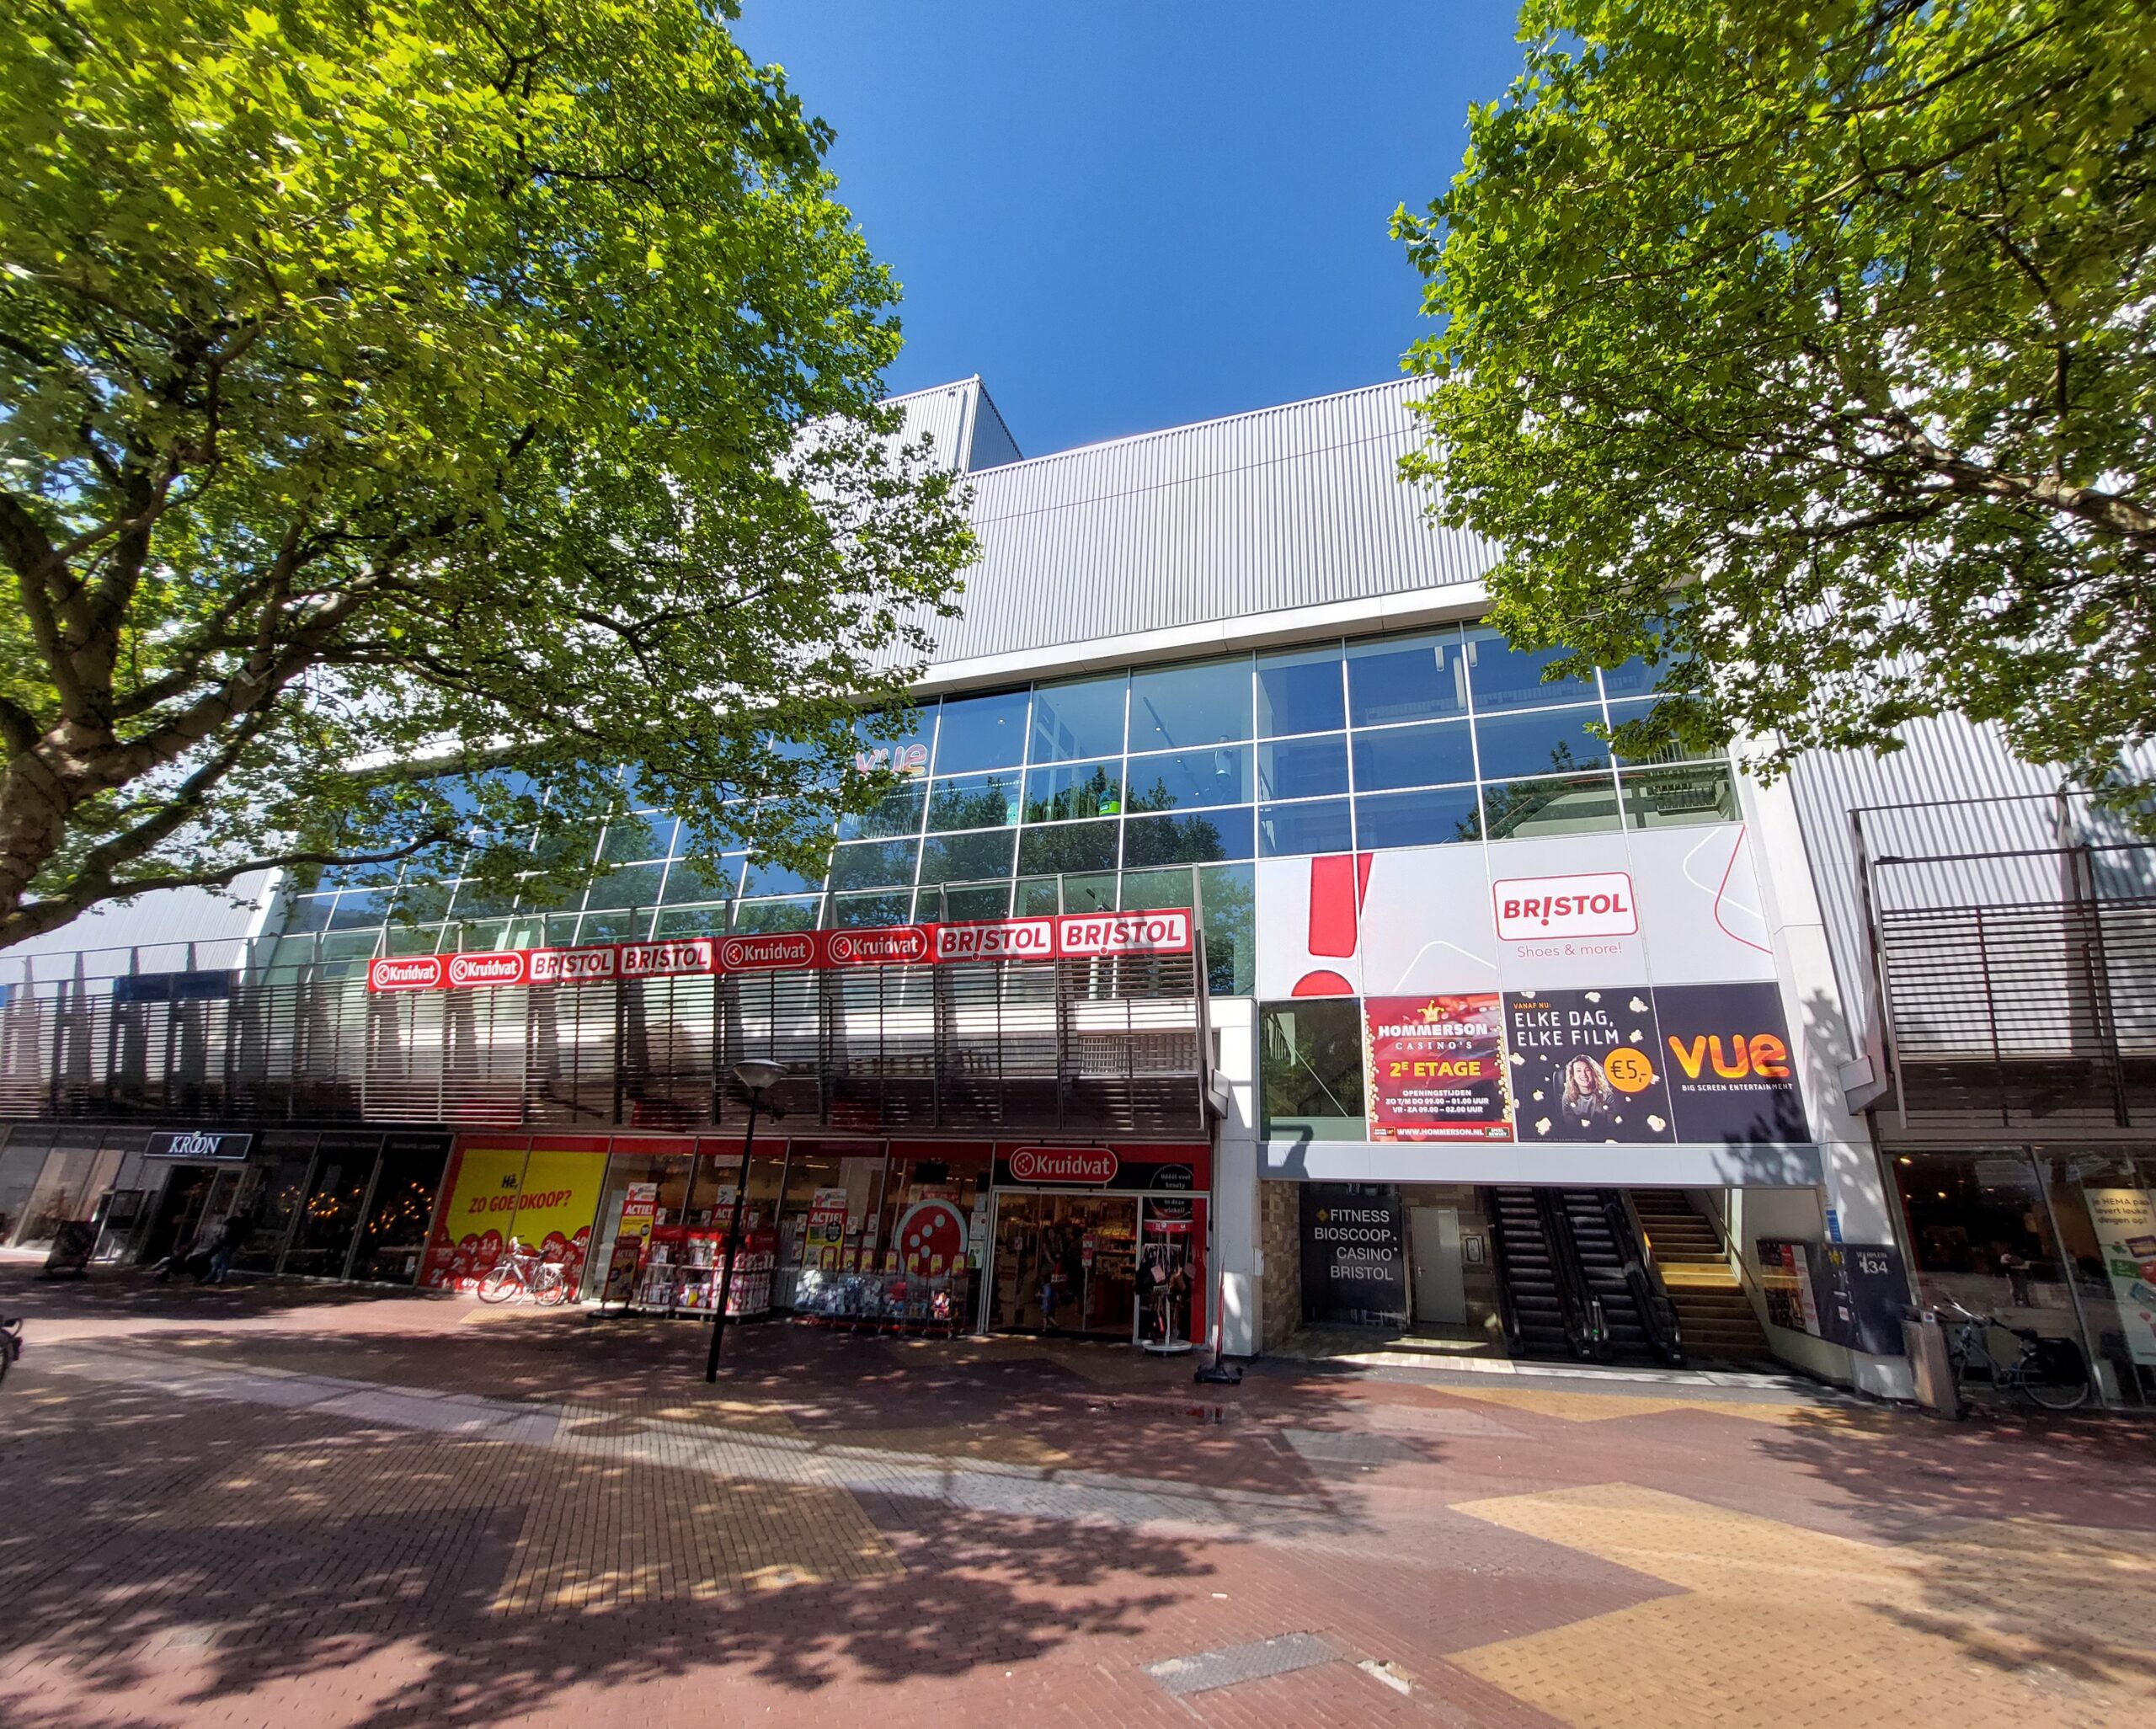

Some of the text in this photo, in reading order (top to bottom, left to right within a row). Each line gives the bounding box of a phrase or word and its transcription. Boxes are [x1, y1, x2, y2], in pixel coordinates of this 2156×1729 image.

[744, 943, 806, 962] Kruidvat
[852, 935, 919, 955] Kruidvat
[1517, 942, 1622, 958] Shoes & more!
[389, 964, 435, 981] Kruidvat
[467, 958, 518, 977] Kruidvat
[1514, 1010, 1614, 1027] ELKE DAG,
[1378, 1023, 1488, 1037] HOMMERSON
[1517, 1029, 1620, 1047] ELKE FILM
[1395, 1041, 1473, 1050] CASINO'S
[1668, 1033, 1790, 1079] vue
[1413, 1061, 1481, 1076] ETAGE
[1610, 1059, 1647, 1083] €5,-
[1729, 1083, 1793, 1091] ENTERTAINMENT
[168, 1135, 221, 1155] KROON
[1036, 1155, 1111, 1176] Kruidvat
[468, 1196, 488, 1214] ZO
[625, 1204, 653, 1215] ACTIE!
[810, 1211, 843, 1224] ACTIE!
[1330, 1209, 1390, 1223] FITNESS
[1314, 1227, 1390, 1242] BIOSCOOP
[1336, 1246, 1392, 1262] CASINO
[1330, 1265, 1394, 1281] BRISTOL
